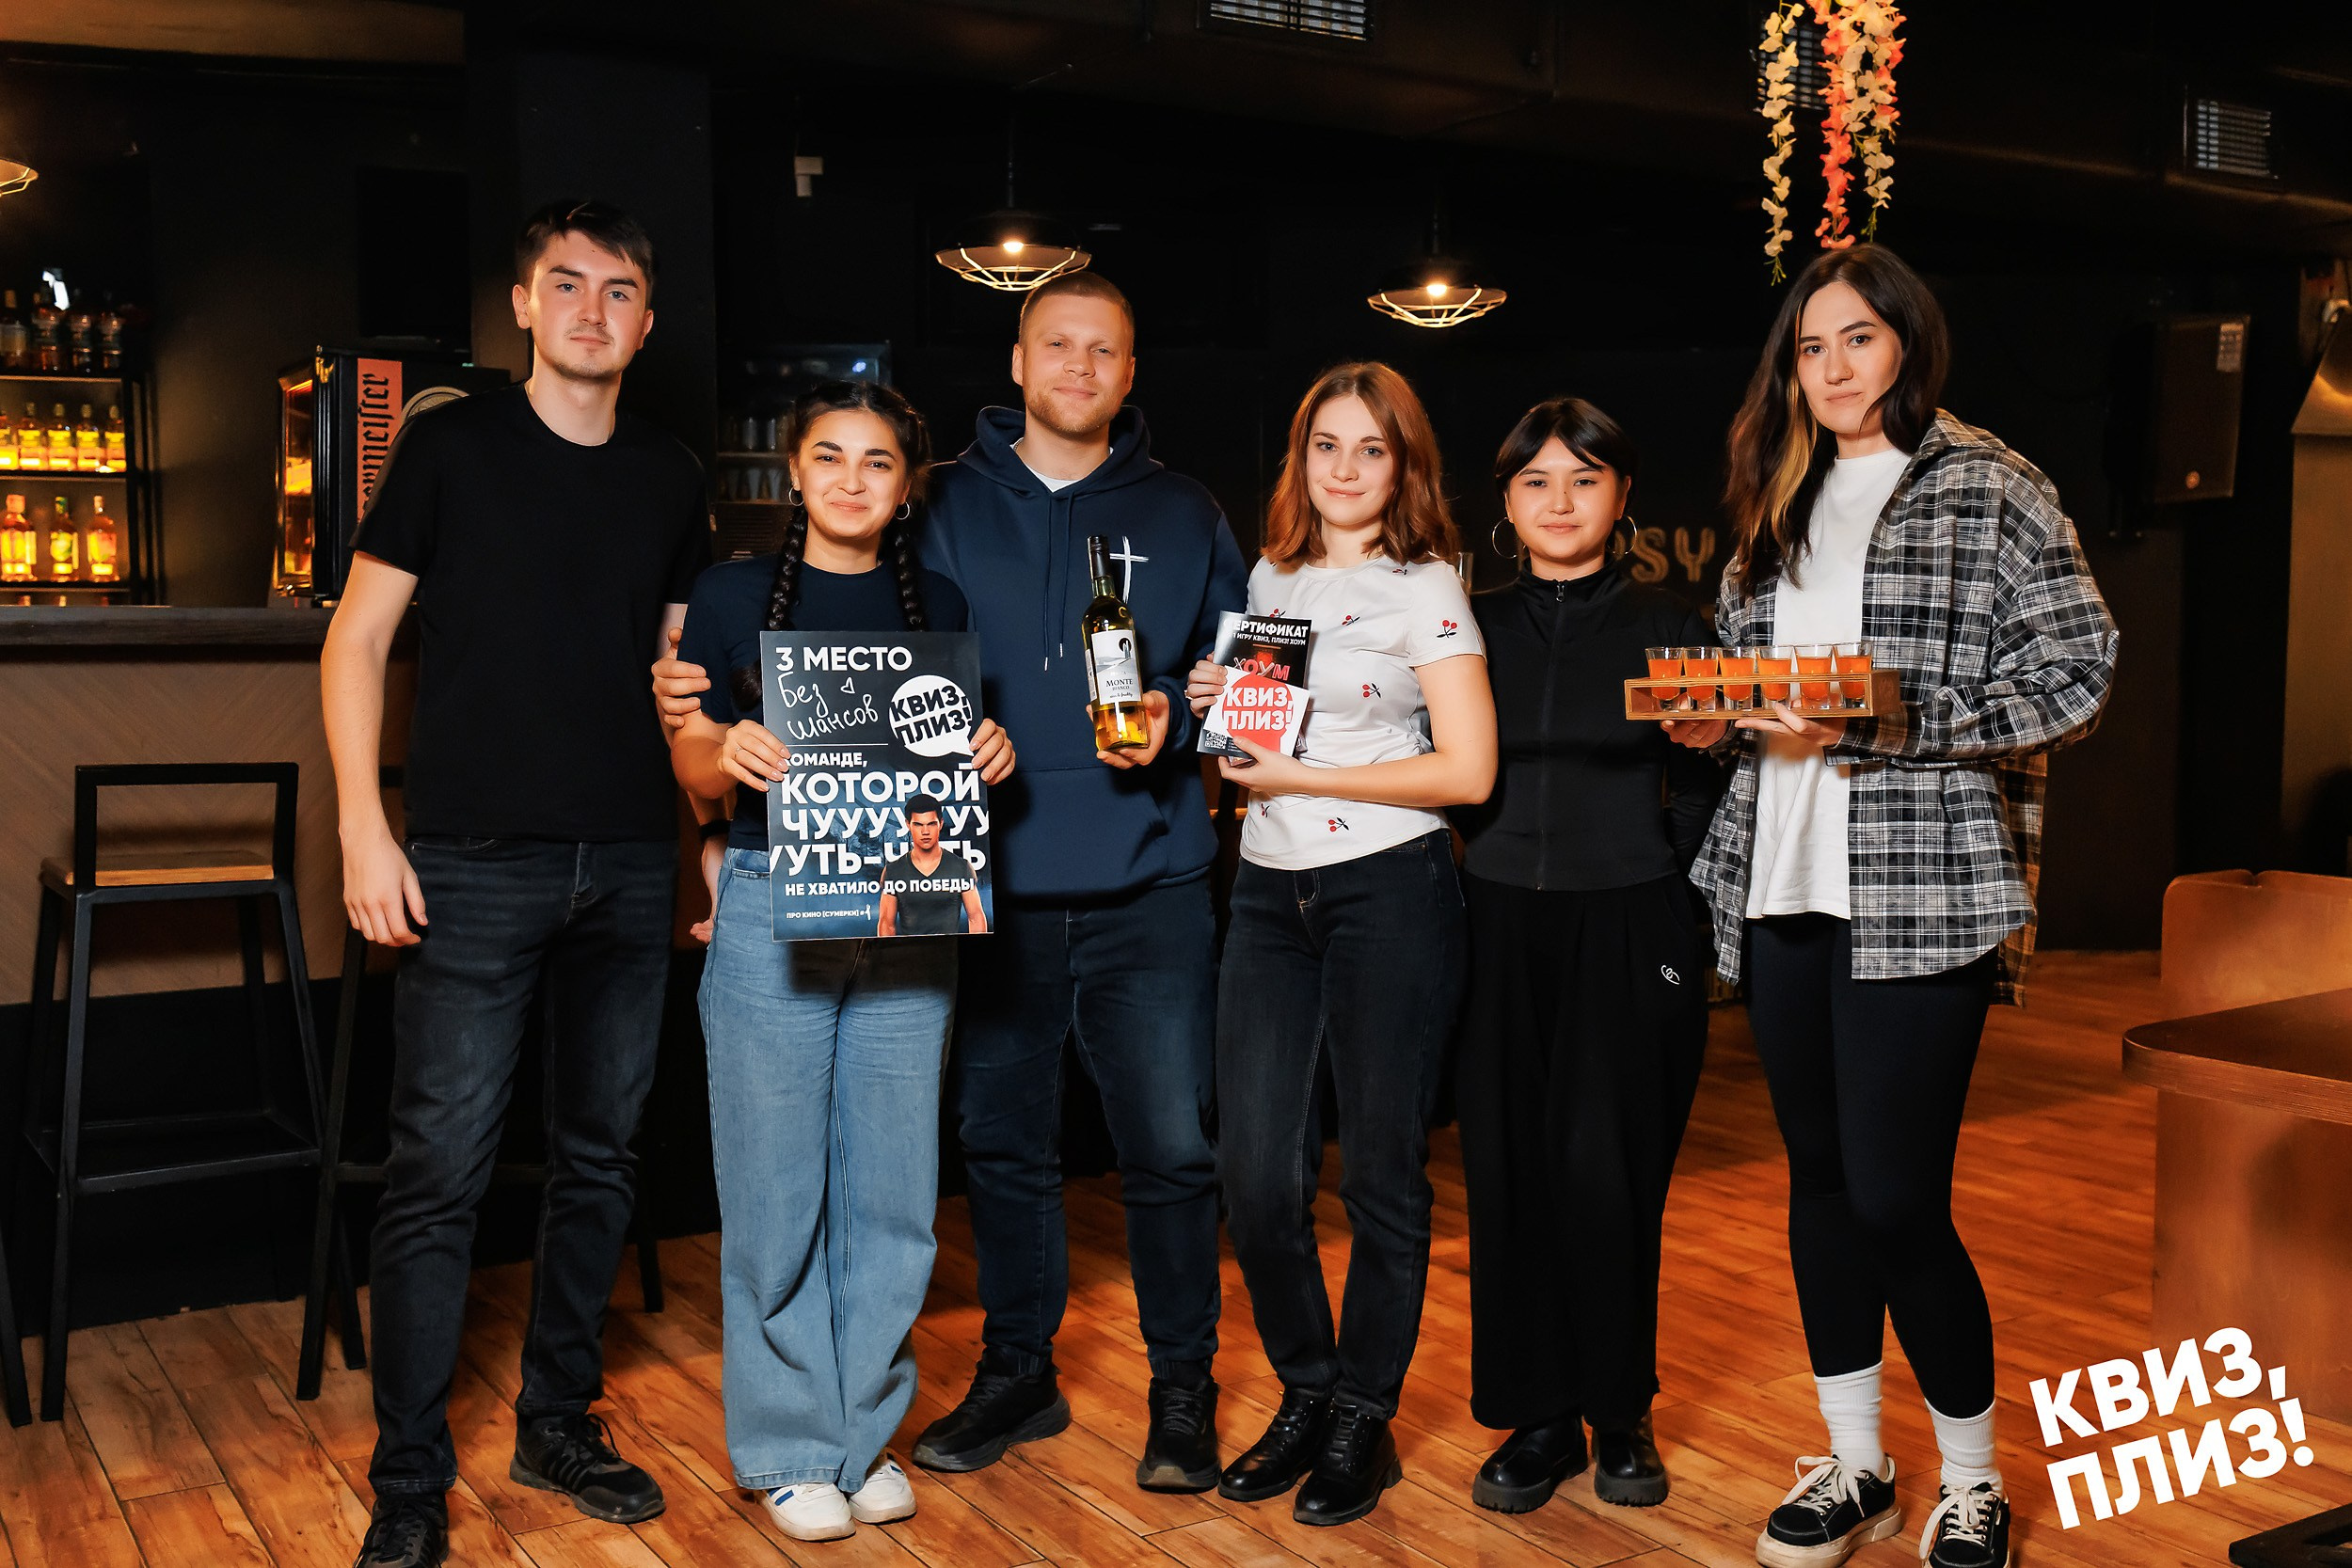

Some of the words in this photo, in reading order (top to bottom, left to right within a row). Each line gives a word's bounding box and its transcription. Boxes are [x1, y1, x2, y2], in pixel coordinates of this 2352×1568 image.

[1614, 526, 1716, 585] SY
[1225, 620, 1309, 638] ЕРТИФИКАТ
[1253, 635, 1270, 643] КВИЗ,
[775, 646, 794, 672] 3
[803, 646, 913, 672] МЕСТО
[1233, 657, 1291, 681] ХОУМ
[777, 671, 828, 718] Без
[1105, 678, 1134, 688] MONTE
[890, 685, 969, 722] КВИЗ,
[1227, 687, 1294, 710] КВИЗ,
[894, 705, 974, 746] ПЛИЗ!
[1224, 710, 1293, 731] ПЛИЗ!
[781, 763, 980, 805] КОТОРОЙ
[785, 883, 805, 896] НЕ
[807, 880, 881, 895] ХВАТИЛО
[882, 879, 907, 895] ДО
[909, 878, 976, 893] ПОБЕДЫ
